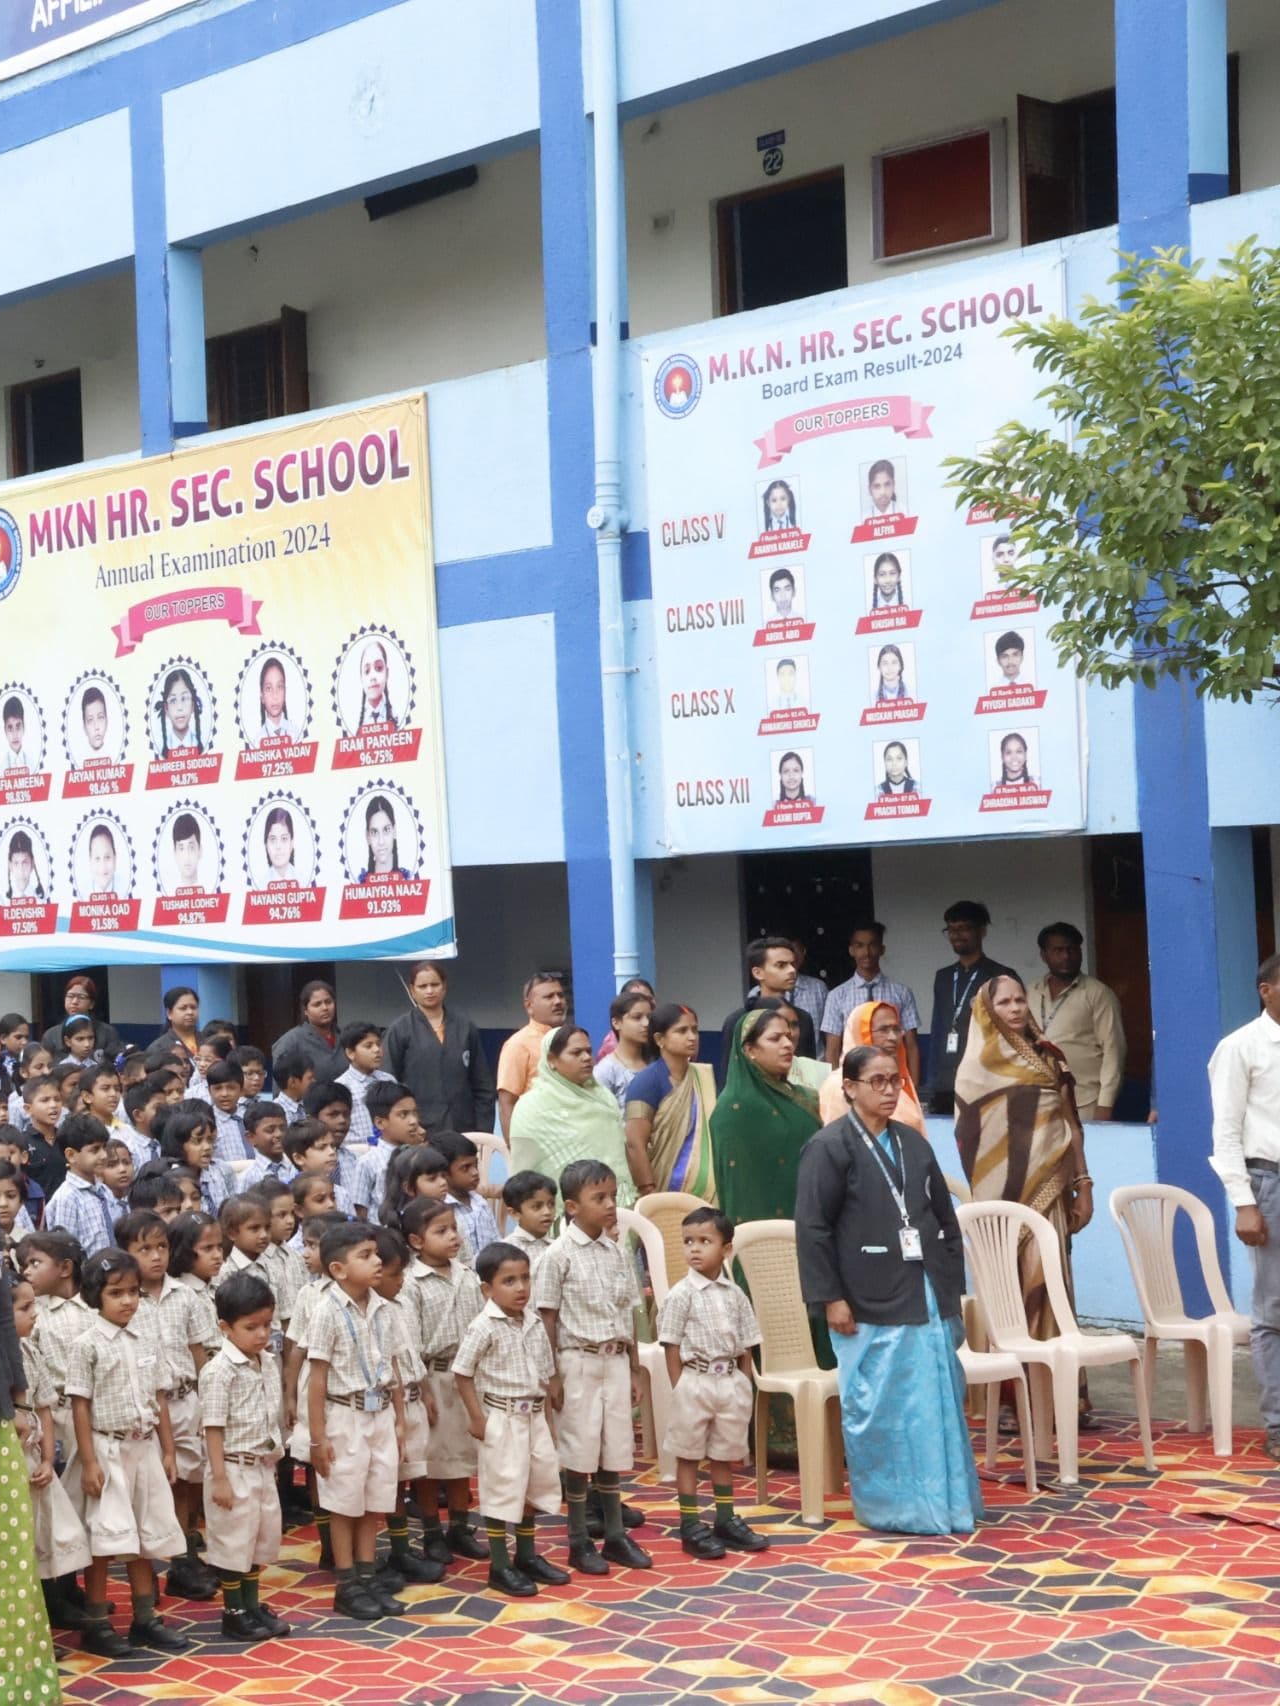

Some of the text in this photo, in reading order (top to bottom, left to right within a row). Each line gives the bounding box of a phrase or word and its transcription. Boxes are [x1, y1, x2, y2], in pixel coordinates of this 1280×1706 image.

[765, 151, 782, 172] 22
[709, 284, 1043, 384] M.K.N. HR. SEC. SCHOOL
[761, 343, 963, 400] Board Exam Result-2024
[794, 402, 890, 433] OUR TOPPERS
[29, 498, 97, 558] MKN
[107, 488, 160, 541] HR.
[171, 468, 243, 528] SEC.
[254, 428, 410, 510] SCHOOL
[662, 512, 725, 548] CLASS V
[95, 521, 331, 590] Annual Examination 2024
[145, 593, 225, 622] OUR TOPPERS
[667, 599, 745, 633] CLASS VIII
[671, 688, 735, 719] CLASS X
[340, 731, 413, 753] IRAM PARVEEN
[240, 745, 311, 764] TANISHKA YADAV
[360, 750, 394, 765] 96.75%
[68, 767, 126, 784] ARYAN KUMAR
[261, 761, 294, 776] 97.25%
[676, 778, 751, 807] CLASS XII
[269, 881, 287, 890] CLASS
[370, 874, 388, 882] CLASS
[250, 890, 317, 906] NAYANSI GUPTA
[345, 883, 423, 900] HUMAIYRA NAAZ
[79, 903, 130, 917] MONIKA OAD
[162, 899, 190, 911] TUSHAR
[269, 906, 301, 920] 94.76%
[367, 899, 401, 914] 91.93%
